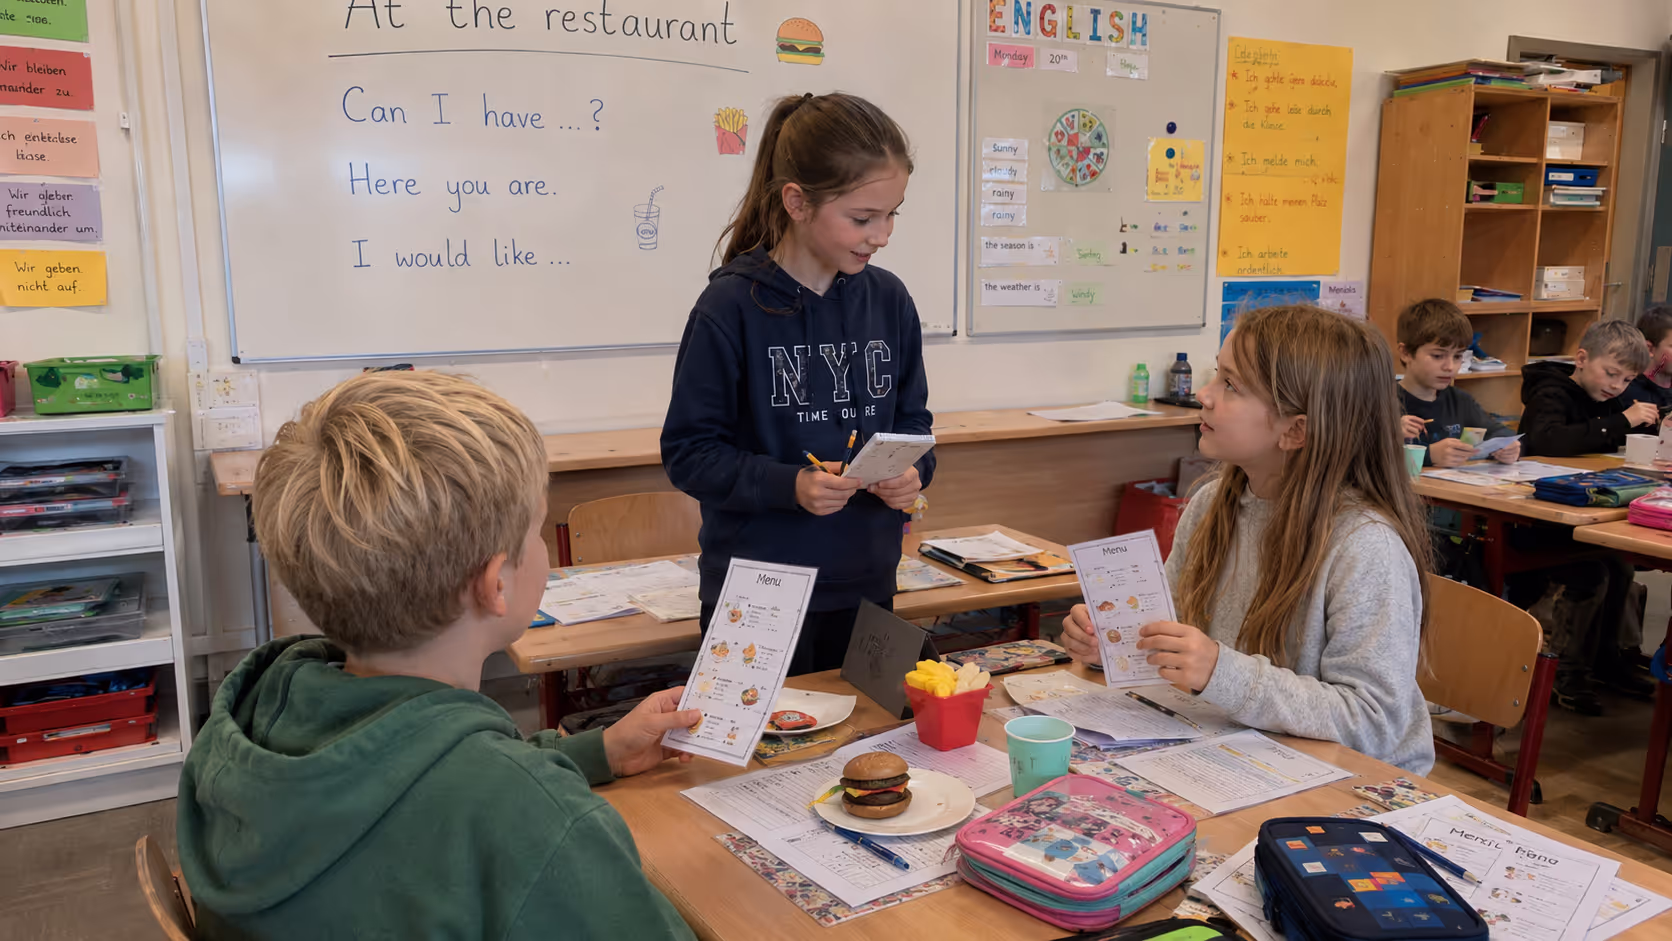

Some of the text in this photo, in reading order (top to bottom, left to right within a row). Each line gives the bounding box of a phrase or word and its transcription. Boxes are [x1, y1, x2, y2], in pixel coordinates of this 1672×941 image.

[345, 0, 738, 45] At the restaurant
[988, 0, 1148, 46] ENGLISH
[993, 49, 1029, 66] Monday
[26, 61, 67, 76] bleiben
[342, 86, 408, 125] Can
[431, 92, 450, 126] I
[483, 93, 546, 131] have
[1244, 100, 1258, 113] Ich
[1241, 151, 1257, 166] Ich
[1263, 153, 1289, 167] melde
[8, 188, 29, 200] Wir
[347, 161, 557, 214] Here you are.
[992, 189, 1015, 201] rainy
[1239, 192, 1255, 207] Ich
[6, 204, 71, 218] freundlich
[992, 211, 1016, 222] rainy
[985, 241, 1035, 250] the season is
[352, 239, 371, 269] I
[395, 238, 471, 269] would
[494, 238, 539, 267] like
[14, 261, 36, 273] Wir
[17, 280, 49, 292] nicht
[984, 283, 1041, 292] the weather is
[768, 339, 892, 407] NYC
[796, 410, 829, 423] TIME
[1102, 545, 1128, 557] Menu
[756, 573, 783, 588] Menu
